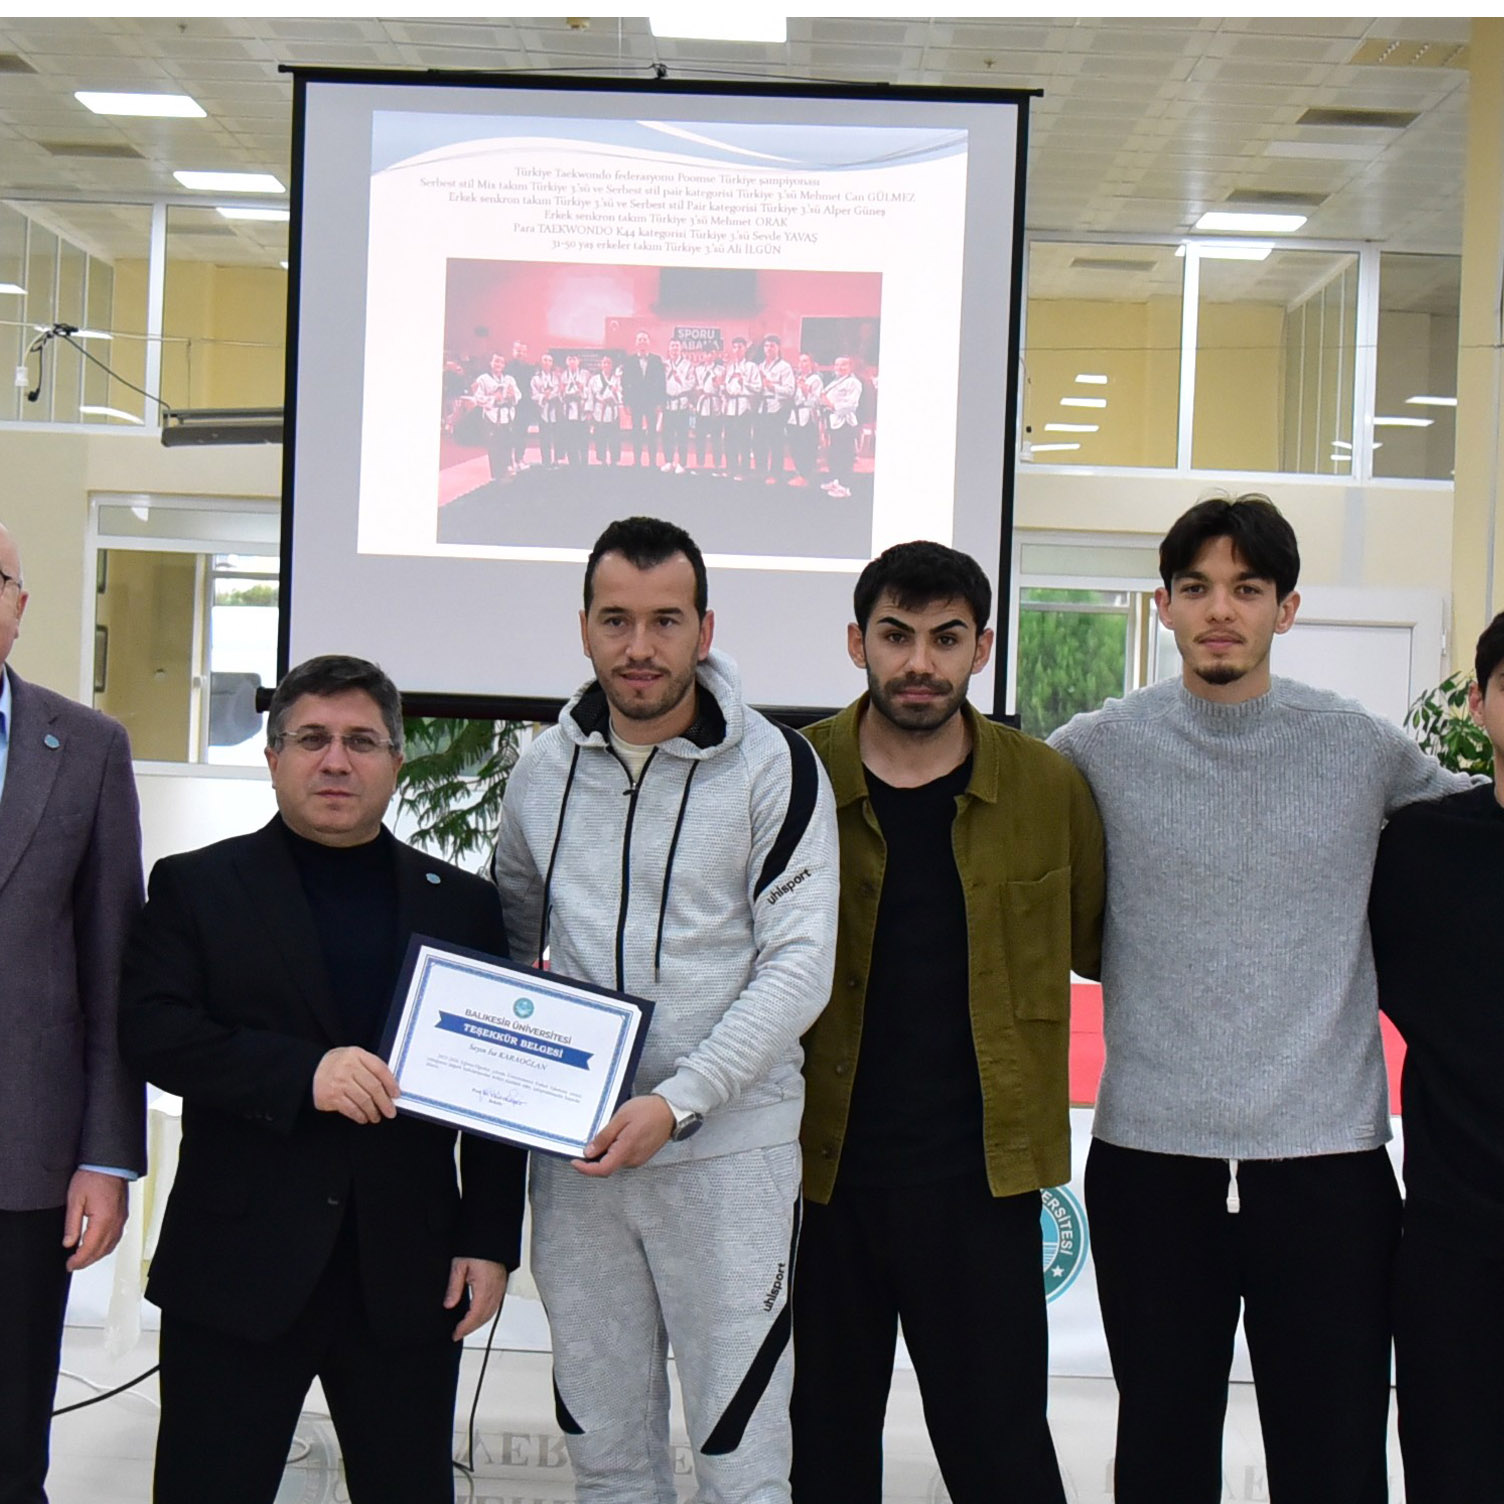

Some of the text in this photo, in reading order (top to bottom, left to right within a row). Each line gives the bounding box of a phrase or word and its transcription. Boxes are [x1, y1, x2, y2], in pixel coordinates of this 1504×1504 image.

[515, 167, 552, 179] Türkiye
[556, 169, 611, 180] Taekwondo
[720, 174, 756, 185] Türkiye
[459, 179, 474, 188] stil
[531, 182, 567, 194] Türkiye
[606, 185, 642, 194] Serbest
[646, 185, 660, 195] stil
[737, 189, 773, 201] Türkiye
[800, 190, 840, 201] Mehmet
[845, 192, 864, 201] Can
[449, 192, 477, 203] Erkek
[480, 195, 519, 204] senkron
[556, 196, 591, 208] Türkiye
[631, 199, 665, 209] Serbest
[669, 200, 684, 210] stil
[761, 203, 797, 215] Türkiye
[824, 205, 850, 217] Alper
[545, 210, 572, 220] Erkek
[575, 212, 615, 222] senkron
[649, 214, 687, 226] Türkiye
[711, 216, 750, 227] Mehmet
[755, 217, 787, 227] ORAK
[514, 223, 535, 233] Para
[538, 224, 612, 235] TAEKWONDO
[691, 229, 726, 242] Türkiye
[784, 232, 818, 243] YAVAŞ
[664, 241, 701, 254] Türkiye
[727, 244, 741, 254] Ali
[678, 329, 715, 339] SPORU
[767, 869, 811, 904] uhlsport
[465, 1009, 572, 1044] BALIKESİR ÜNİVERSİTESİ
[464, 1023, 564, 1058] TEŞEKKÜR BELGESİ
[1041, 1189, 1073, 1255] ERSİTESİ
[764, 1263, 785, 1312] uhlsport
